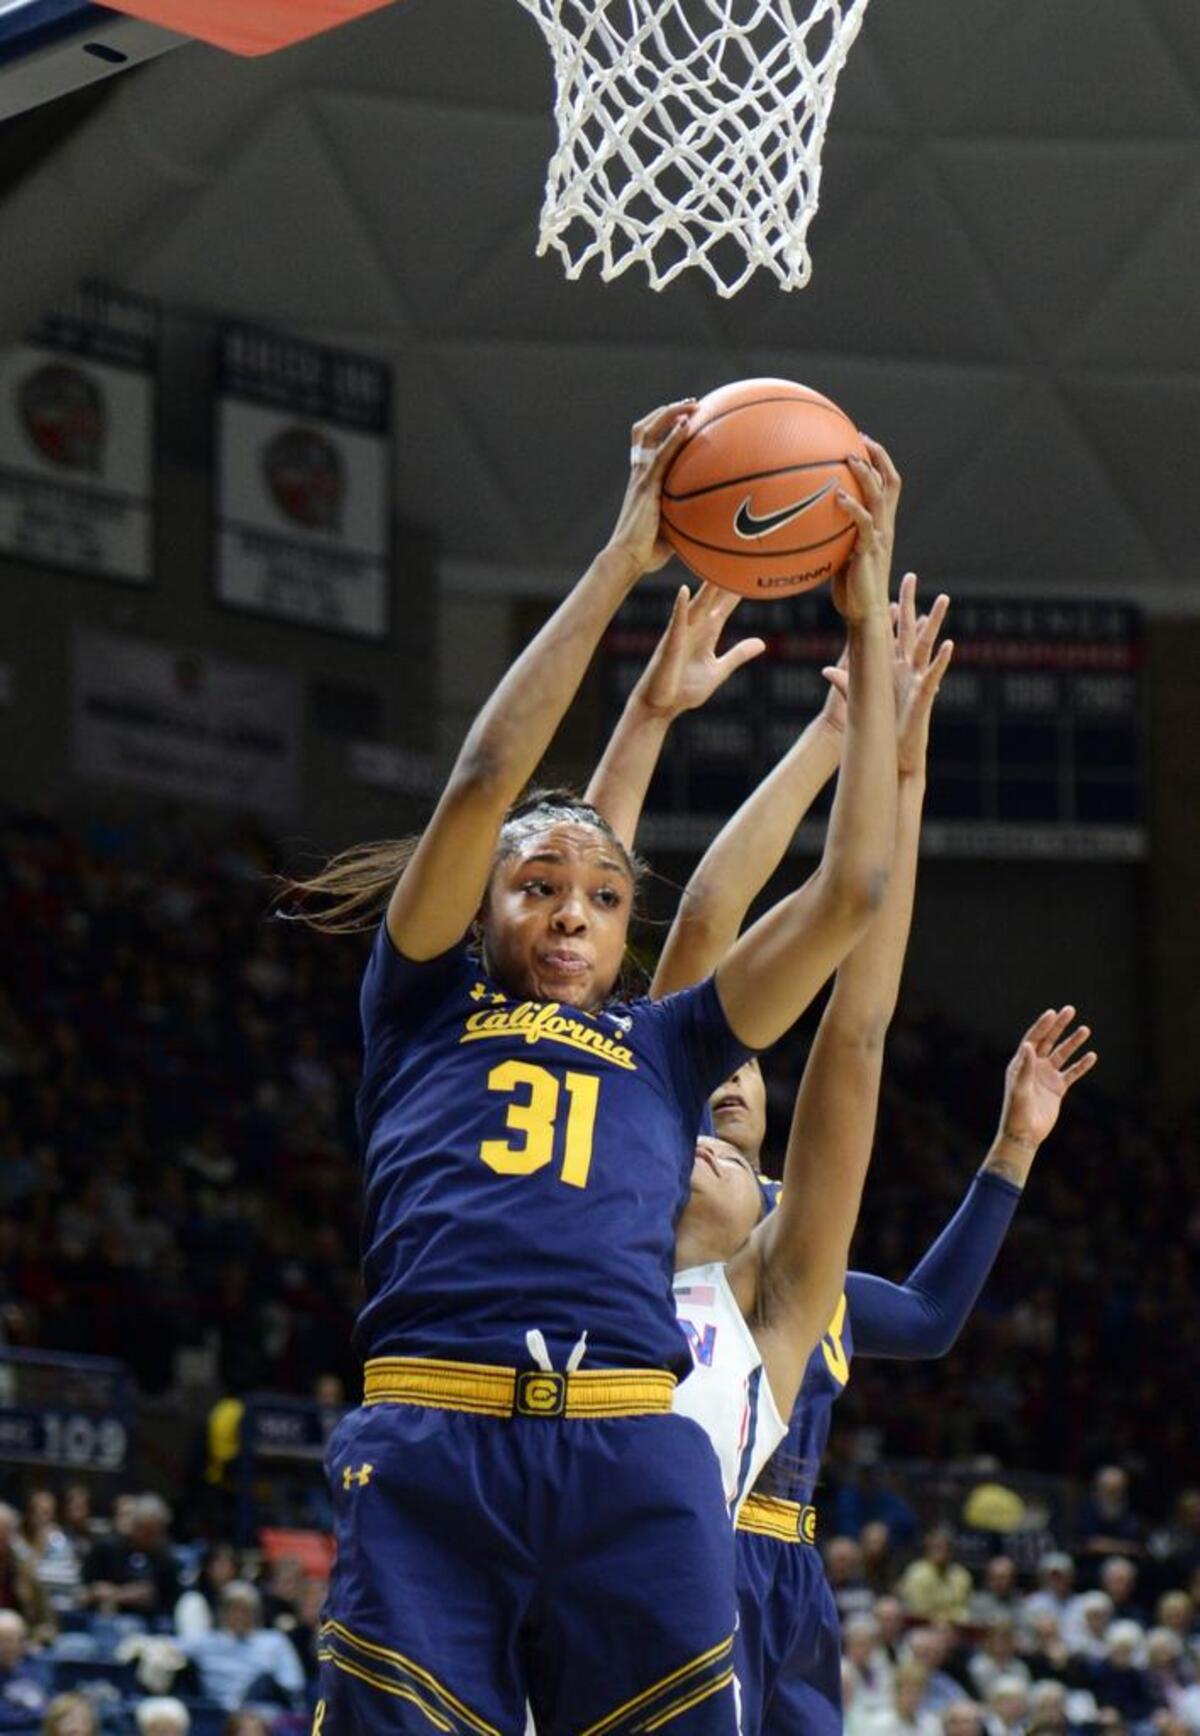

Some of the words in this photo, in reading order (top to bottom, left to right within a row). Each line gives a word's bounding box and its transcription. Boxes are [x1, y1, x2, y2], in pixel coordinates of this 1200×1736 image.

[758, 562, 833, 588] UCONN
[460, 1001, 637, 1071] California
[480, 1060, 601, 1190] 31
[525, 1379, 558, 1410] C
[44, 1412, 128, 1468] 109
